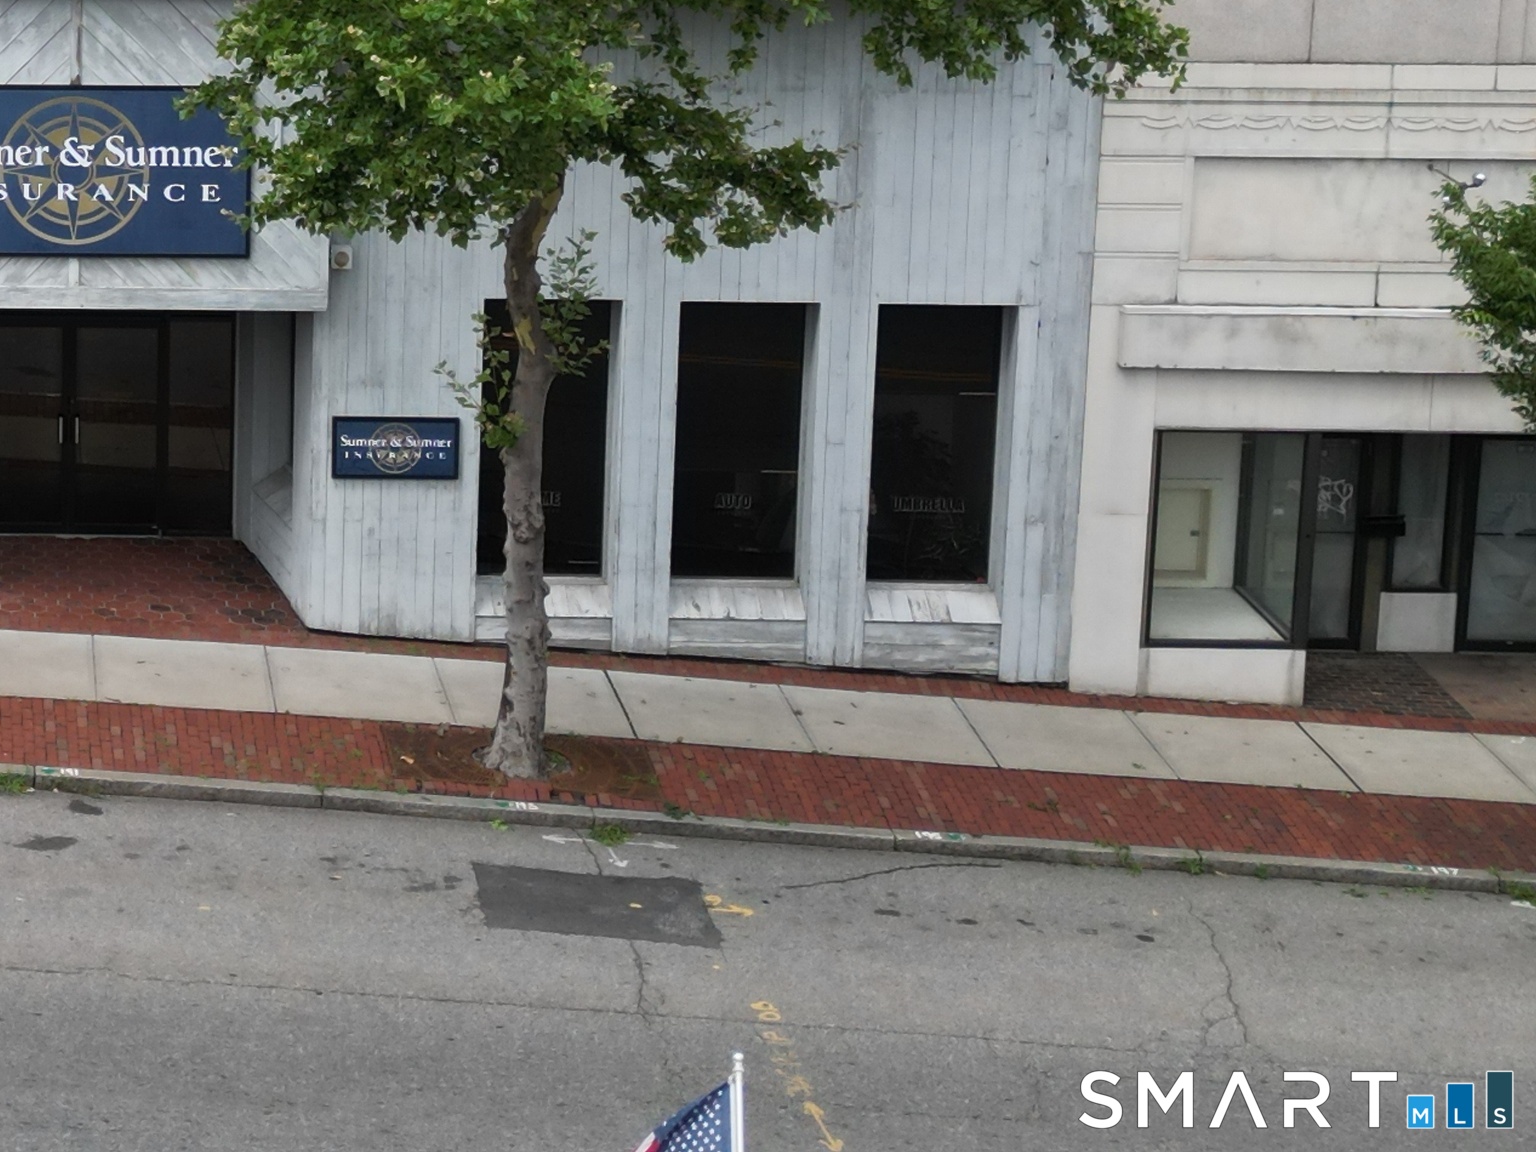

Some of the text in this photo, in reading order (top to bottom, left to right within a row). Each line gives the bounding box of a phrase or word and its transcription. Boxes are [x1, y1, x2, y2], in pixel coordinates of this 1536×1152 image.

[60, 137, 93, 168] &
[105, 135, 238, 168] Sumner
[340, 434, 452, 447] Sumner & Sumner
[714, 492, 752, 509] AUTO
[892, 495, 965, 514] UMBRELLA
